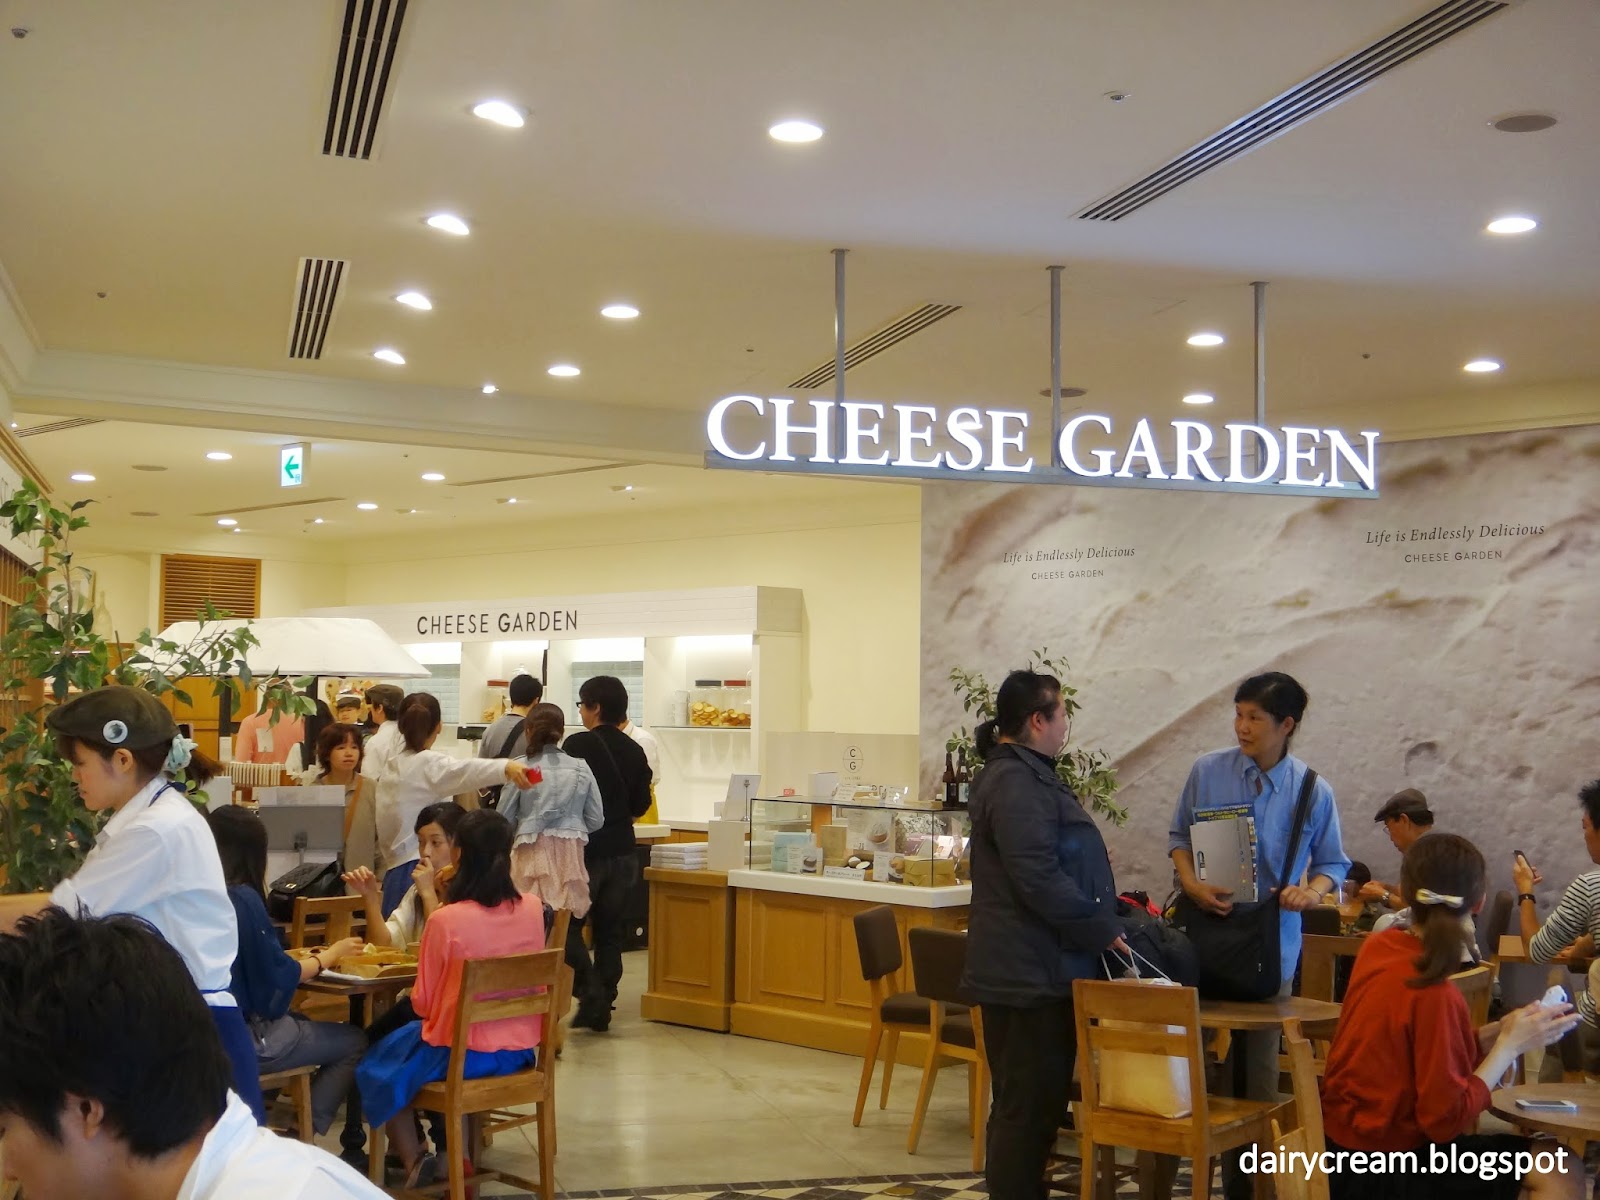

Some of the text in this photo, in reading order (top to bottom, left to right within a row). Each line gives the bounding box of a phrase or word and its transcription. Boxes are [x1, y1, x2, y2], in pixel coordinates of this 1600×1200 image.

[706, 395, 1381, 490] CHEESE GARDEN
[1366, 523, 1546, 546] Life is Endlessly Delicious
[1003, 546, 1135, 566] Life is Endlessly Delicious
[1404, 550, 1502, 563] CHEESE GARDEN
[1031, 569, 1104, 580] CHEESE GARDEN
[417, 610, 577, 635] CHEESE GARDEN
[849, 748, 857, 758] C
[849, 761, 857, 771] G
